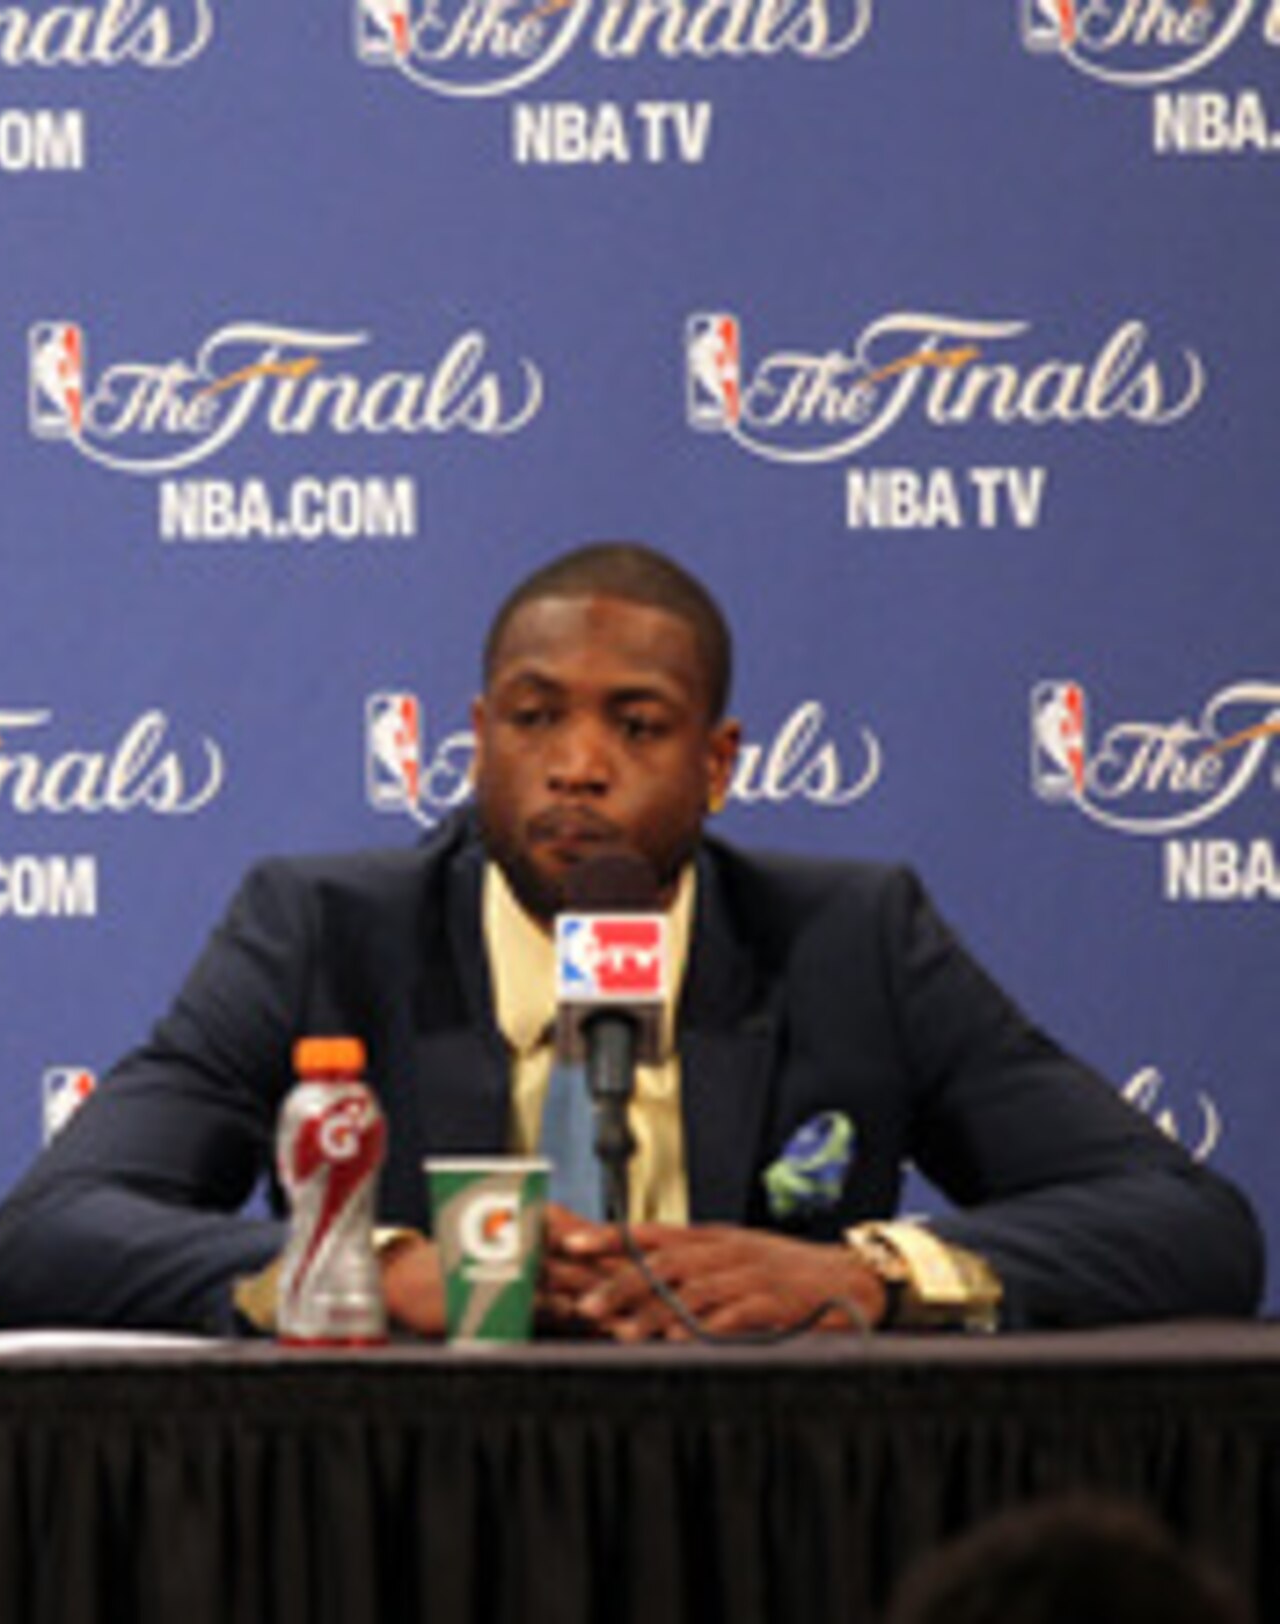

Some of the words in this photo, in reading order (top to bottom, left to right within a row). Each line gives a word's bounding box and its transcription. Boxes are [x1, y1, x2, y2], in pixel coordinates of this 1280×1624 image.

[400, 0, 872, 97] Finals
[415, 0, 549, 59] The
[513, 102, 631, 164] NBA
[636, 101, 712, 163] TV
[73, 324, 545, 474] Finals
[88, 361, 222, 436] The
[733, 314, 1205, 464] Finals
[748, 351, 882, 426] The
[159, 476, 416, 541] NBA.COM
[846, 468, 962, 530] NBA
[969, 467, 1046, 528] TV
[1084, 717, 1224, 797] The
[319, 1113, 360, 1160] G
[459, 1192, 523, 1262] G
